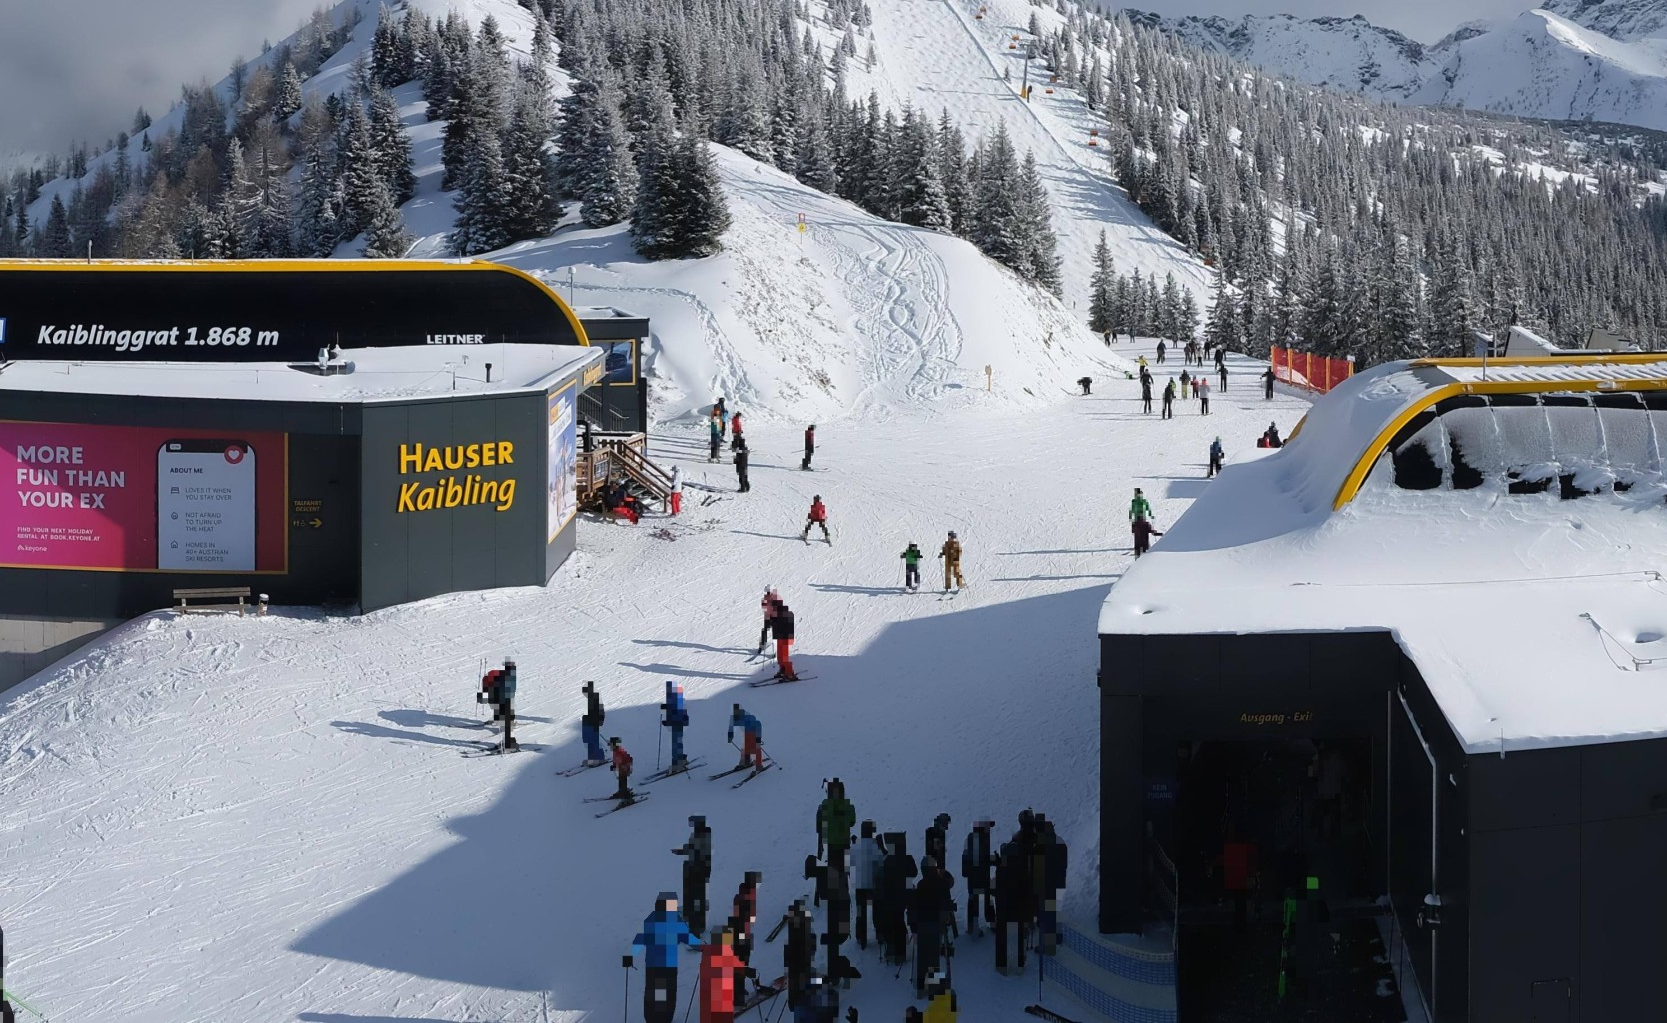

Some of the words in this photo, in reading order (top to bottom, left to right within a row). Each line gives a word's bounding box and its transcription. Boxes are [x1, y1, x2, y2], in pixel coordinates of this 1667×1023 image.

[37, 324, 180, 352] Kaiblinggrat
[184, 327, 252, 346] 1.868
[256, 330, 280, 346] m
[426, 334, 484, 345] LEITNER
[17, 445, 84, 464] MORE
[399, 441, 514, 474] HAUSER
[17, 468, 59, 486] FUN
[65, 470, 125, 488] THAN
[18, 491, 73, 508] YOUR
[80, 493, 105, 509] EX
[397, 474, 517, 513] Kaibling
[1240, 712, 1285, 725] Ausgang
